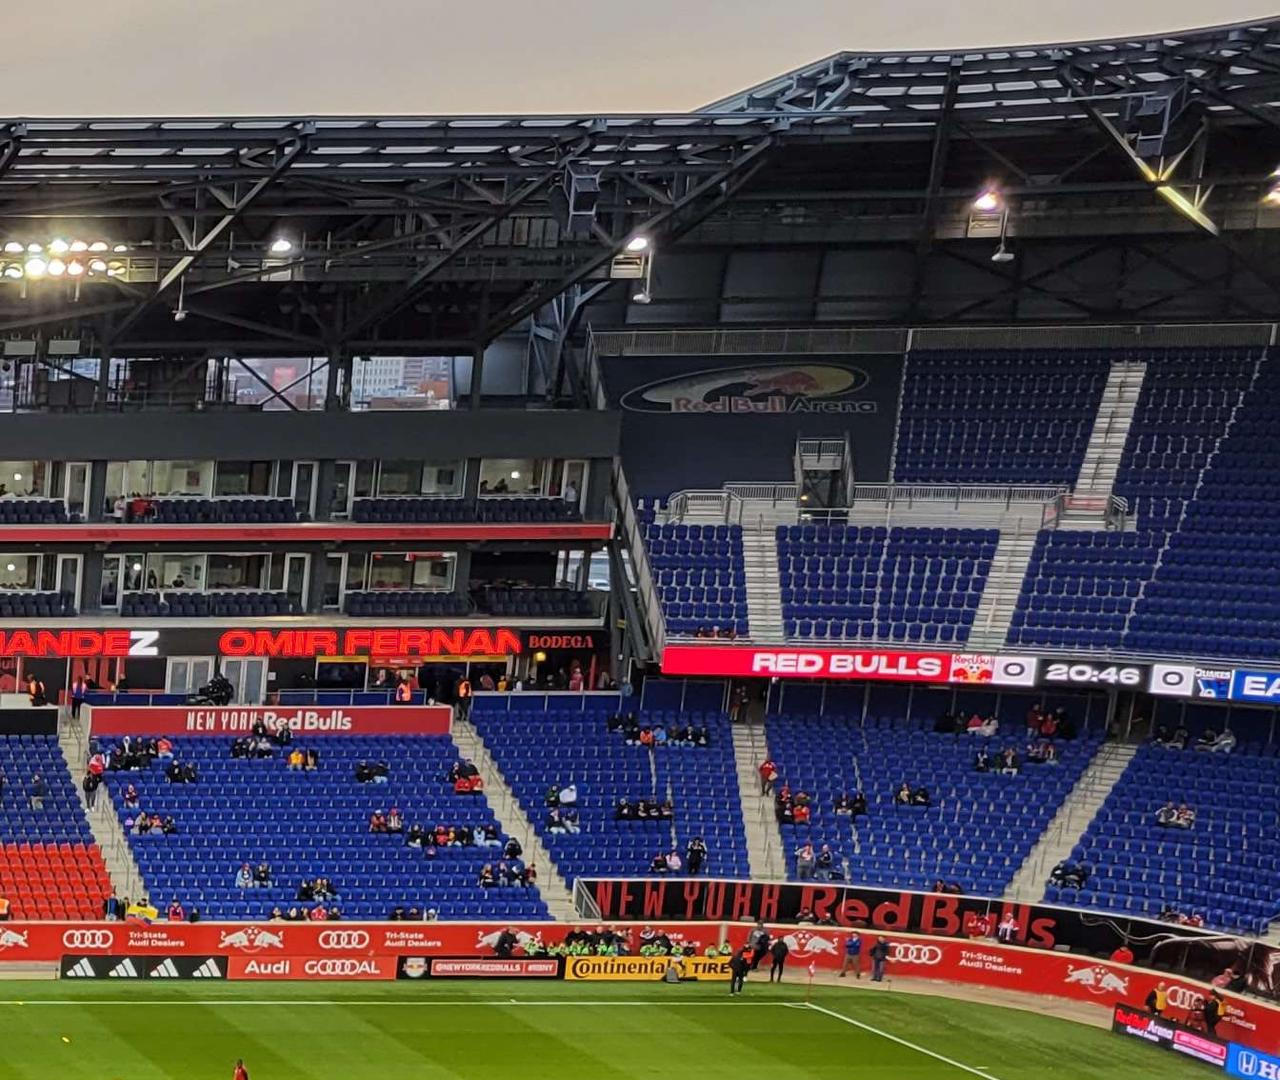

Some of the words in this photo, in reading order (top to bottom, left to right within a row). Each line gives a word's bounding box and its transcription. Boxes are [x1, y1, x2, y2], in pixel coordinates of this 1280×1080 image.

[789, 397, 877, 413] Arena
[218, 629, 338, 656] OMIR
[528, 635, 593, 649] BODEGA
[752, 652, 824, 673] RED
[829, 654, 942, 677] BULLS
[1044, 663, 1140, 685] 20:46
[186, 711, 216, 730] NEW
[221, 711, 258, 730] YORK
[596, 880, 667, 919] NEW
[683, 882, 781, 921] YORK
[128, 931, 168, 939] Tri-State
[384, 932, 424, 940] Tri-State
[128, 939, 149, 947] Audi
[151, 939, 185, 947] Dealers
[960, 950, 1003, 963] Tri-State
[244, 960, 290, 974] Audi
[691, 962, 730, 974] TIRE
[959, 959, 983, 969] Audi
[984, 962, 1022, 975] Dealers
